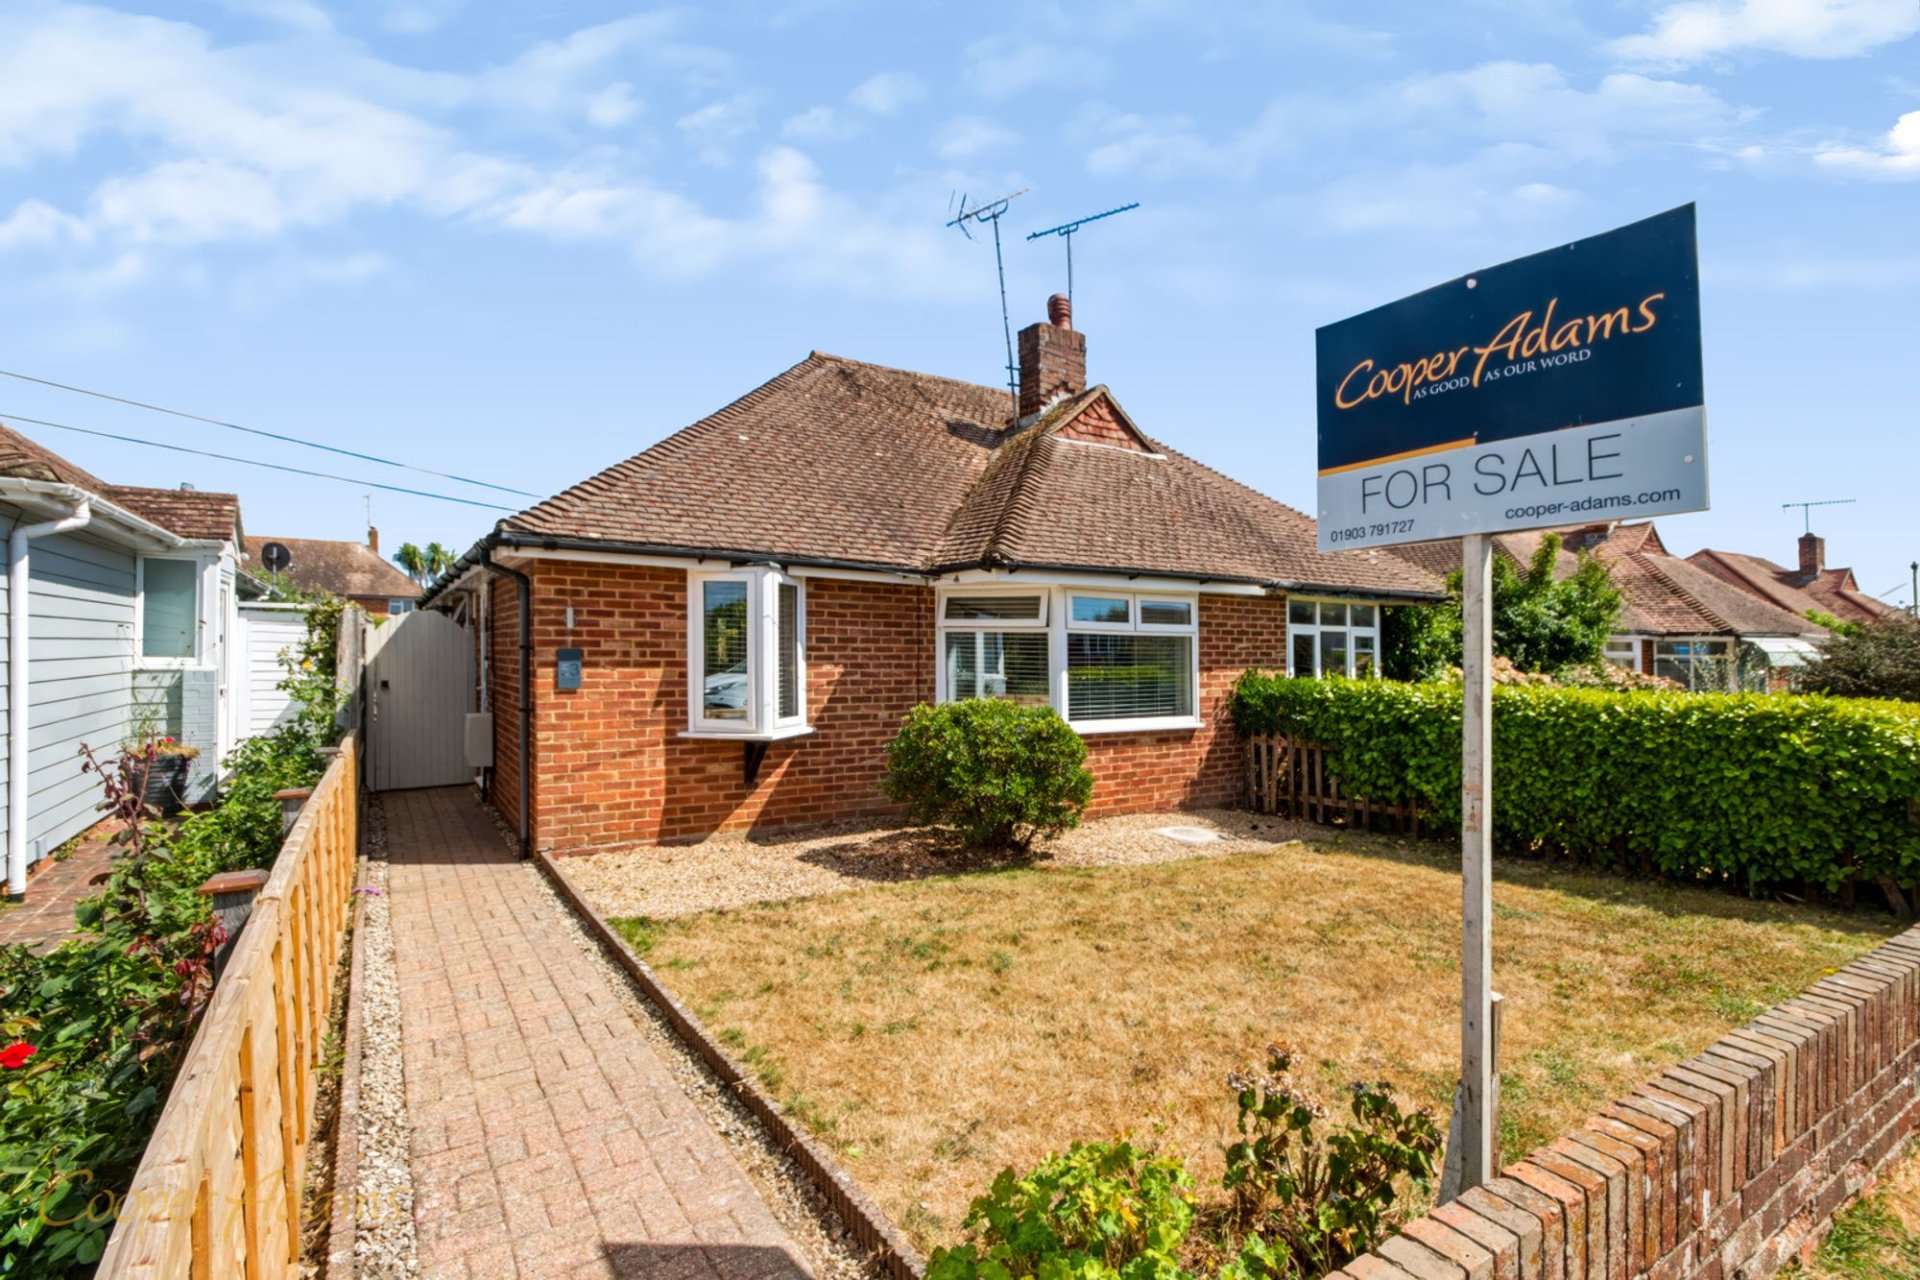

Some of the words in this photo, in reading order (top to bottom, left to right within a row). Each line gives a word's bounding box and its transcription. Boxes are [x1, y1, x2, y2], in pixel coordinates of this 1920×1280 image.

[1335, 344, 1470, 410] Cooper
[1473, 293, 1664, 388] Adams
[1413, 387, 1427, 400] AS
[1429, 376, 1470, 396] GOOD
[1485, 367, 1500, 382] AS
[1504, 360, 1537, 378] OUR
[1540, 348, 1591, 371] WORD
[1361, 463, 1451, 514] FOR
[1473, 433, 1623, 496] SALE
[1505, 486, 1681, 520] cooper-adams.com
[1330, 526, 1366, 543] 01903
[1369, 519, 1414, 537] 791727
